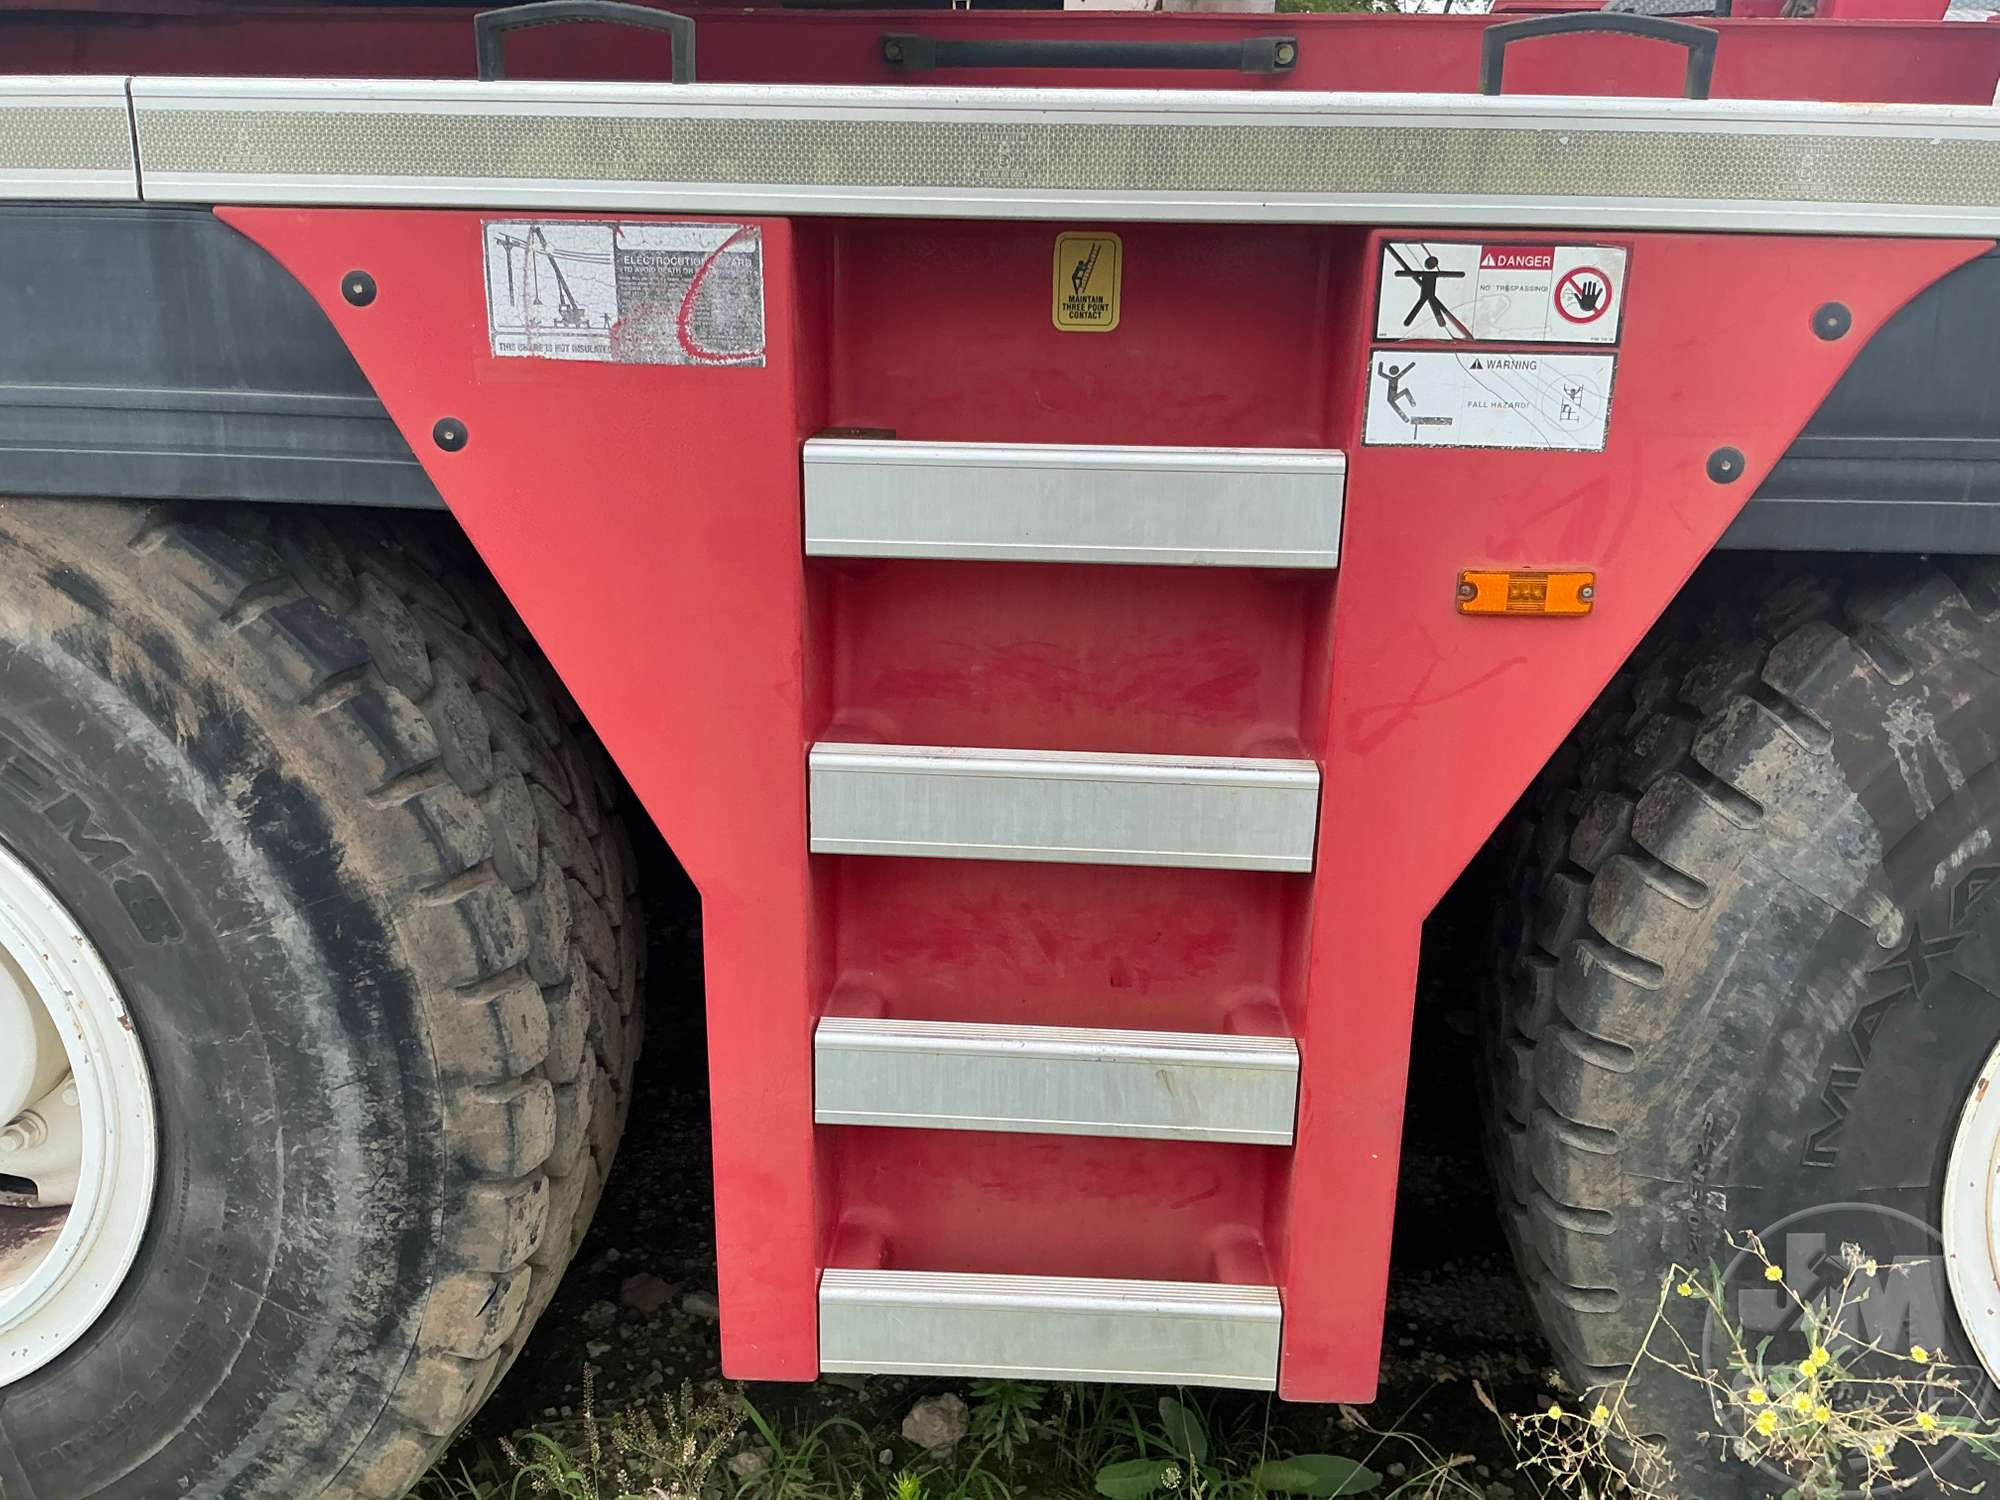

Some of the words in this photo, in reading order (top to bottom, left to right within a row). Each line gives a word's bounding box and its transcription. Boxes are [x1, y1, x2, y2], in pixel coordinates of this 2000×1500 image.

[1497, 255, 1551, 268] DANGER
[1480, 284, 1491, 292] NO
[1068, 295, 1104, 303] MAINTAIN
[1062, 303, 1086, 311] THREE
[1088, 303, 1109, 311] POINT
[1068, 311, 1102, 320] CONTACT
[1487, 359, 1537, 370] WARNING
